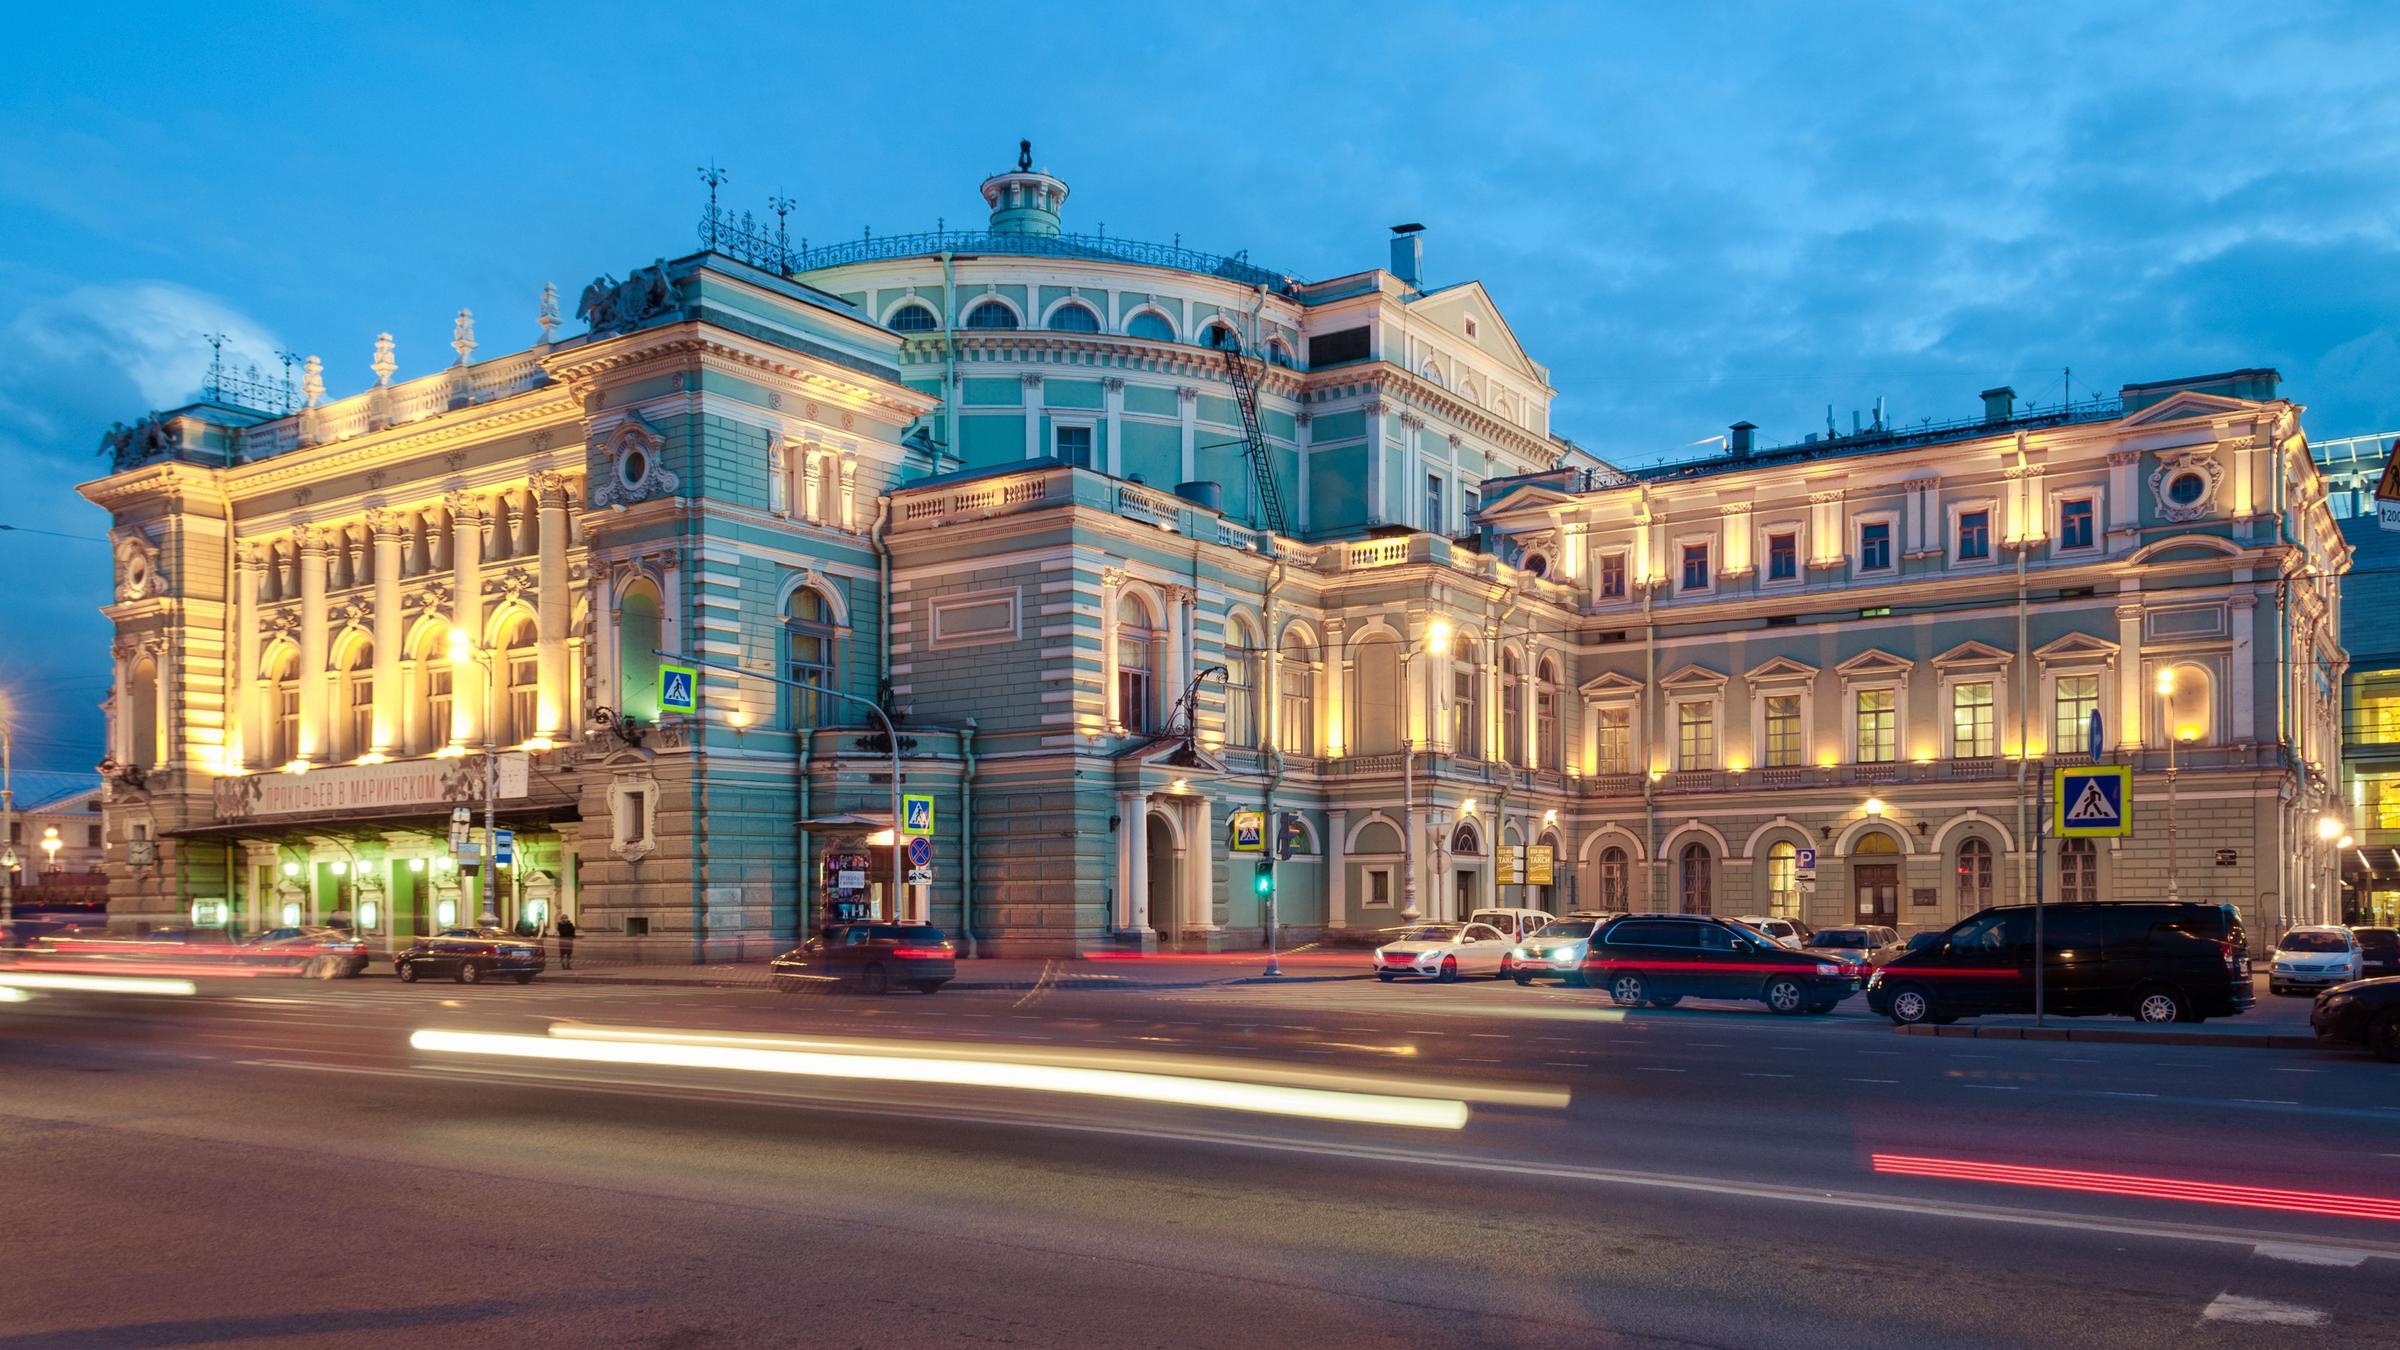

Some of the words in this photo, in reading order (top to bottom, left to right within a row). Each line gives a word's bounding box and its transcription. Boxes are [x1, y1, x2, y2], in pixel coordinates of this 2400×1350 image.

[266, 782, 333, 810] ПРОКОФЬЕВ
[339, 781, 345, 805] В
[350, 774, 436, 804] МАРИИНСКОМ
[1530, 856, 1550, 864] ТАКСИ
[1801, 851, 1812, 867] P
